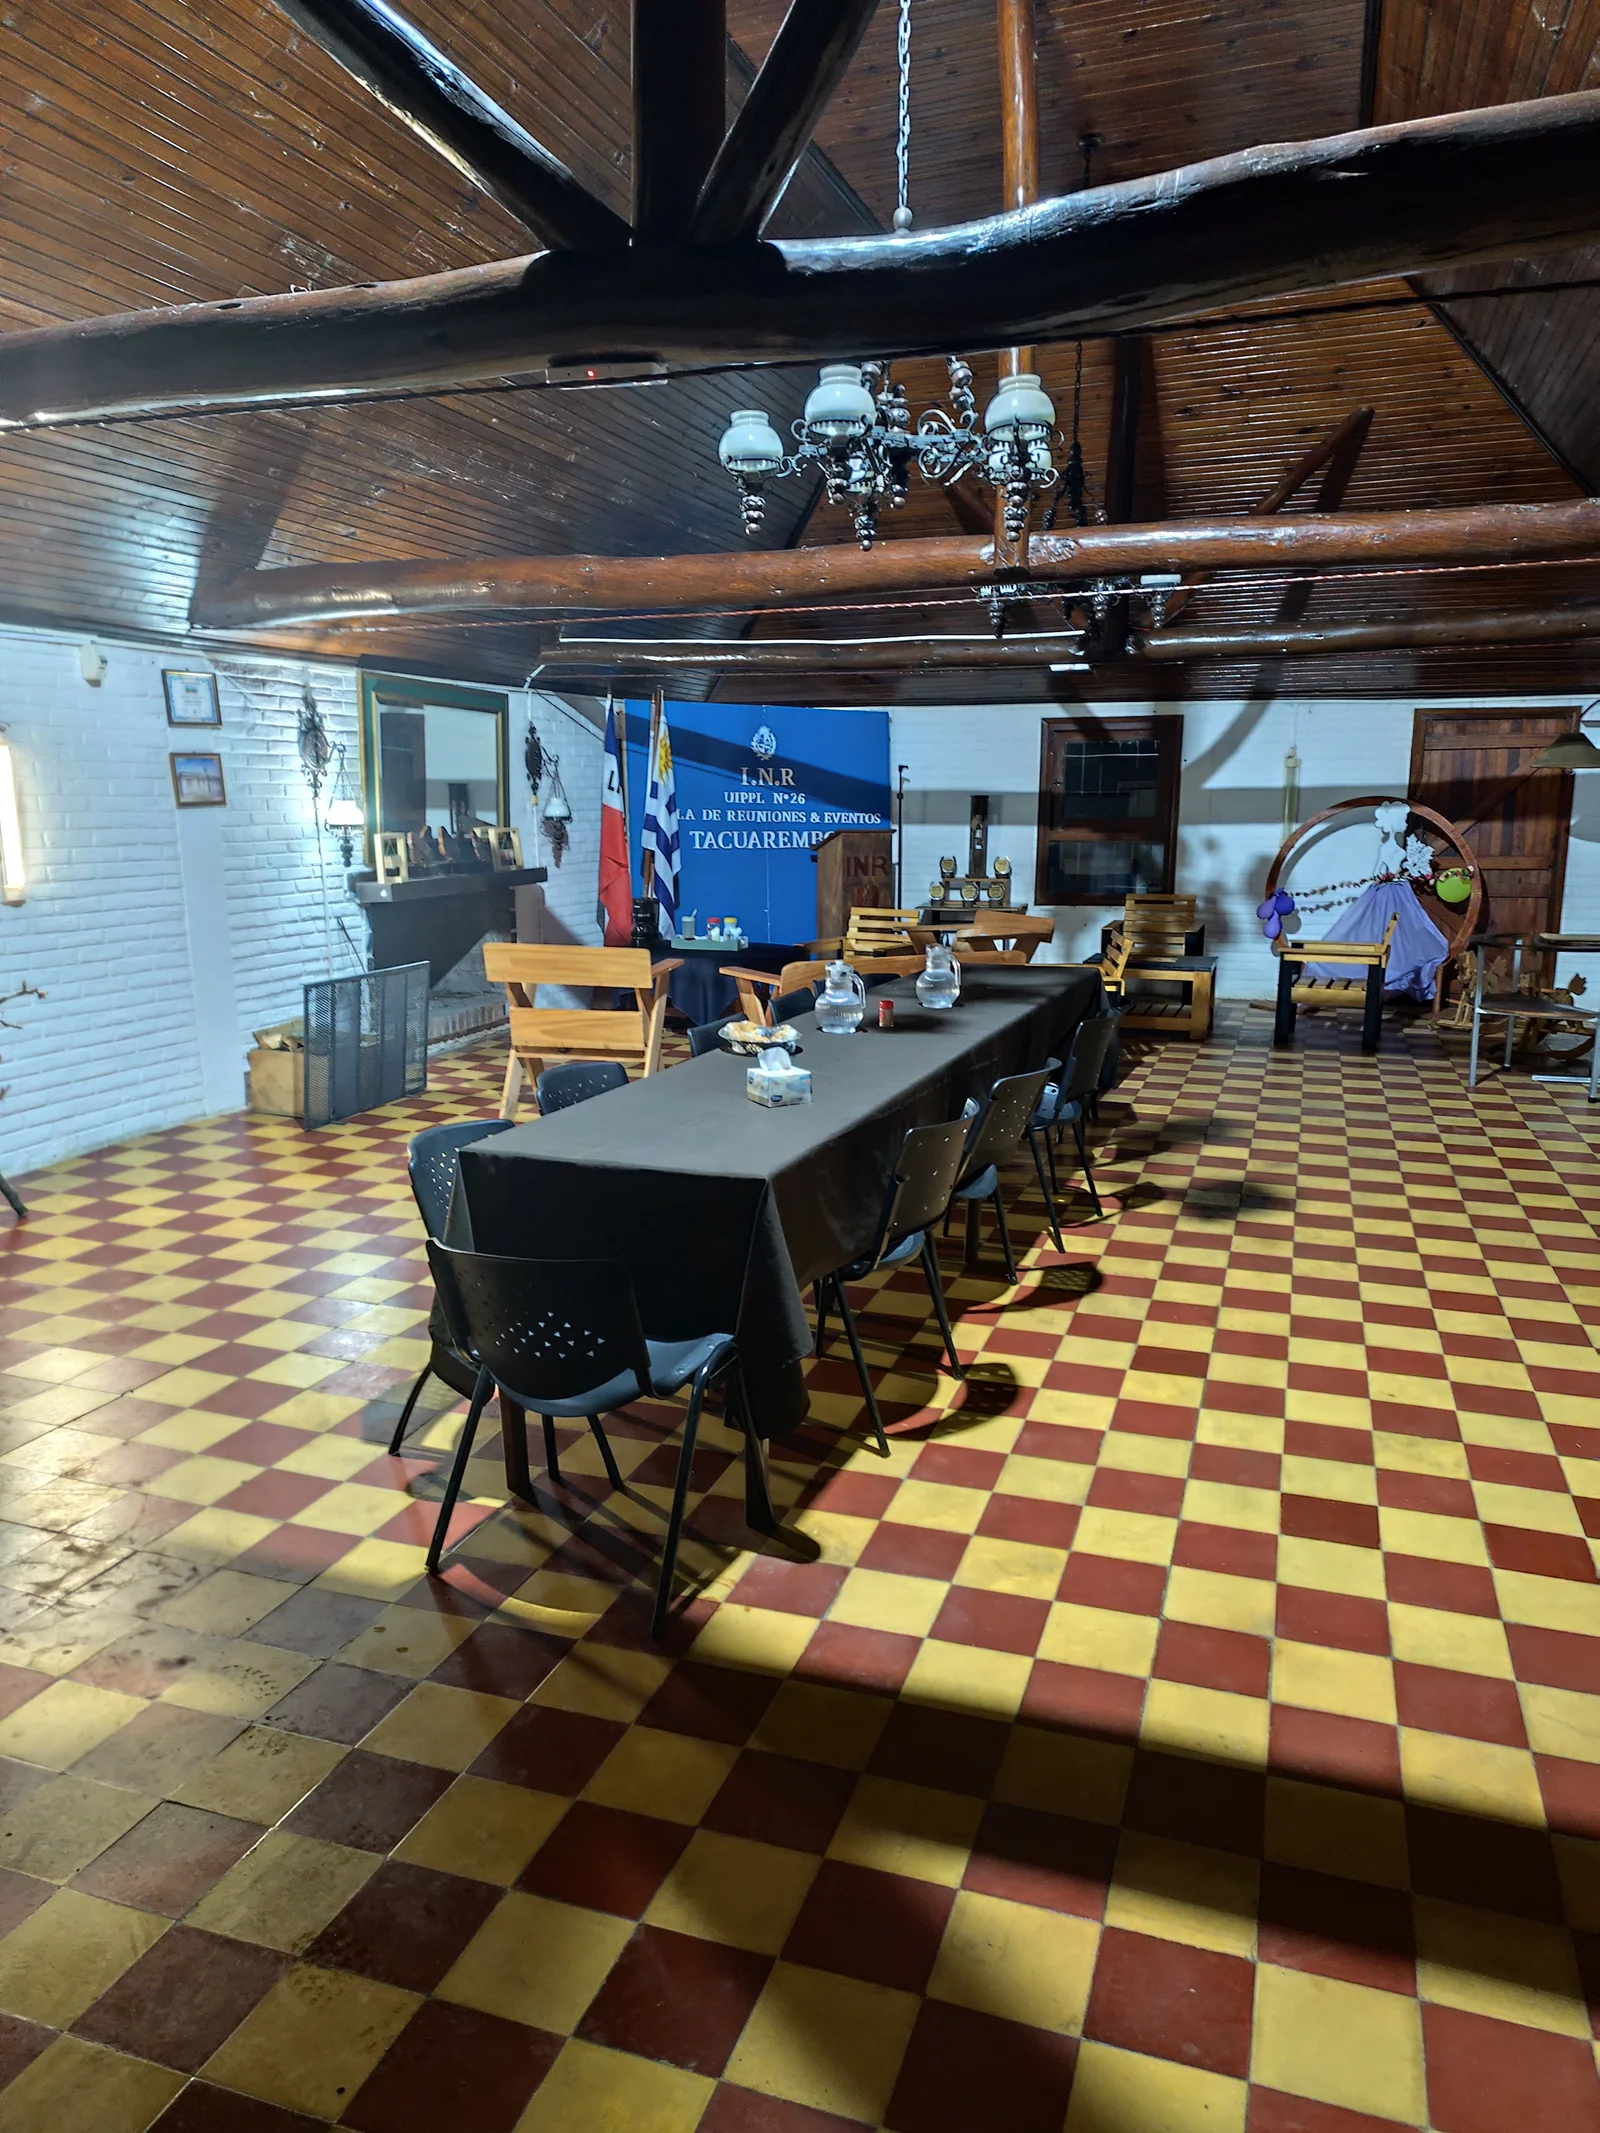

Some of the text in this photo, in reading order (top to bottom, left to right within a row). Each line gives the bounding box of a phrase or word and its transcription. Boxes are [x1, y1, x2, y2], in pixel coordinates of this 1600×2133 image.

[740, 766, 796, 786] I.N.R
[723, 791, 765, 804] UIPPL
[676, 808, 882, 824] LA DE REUNIONES & EVENTOS
[845, 855, 889, 877] INR
